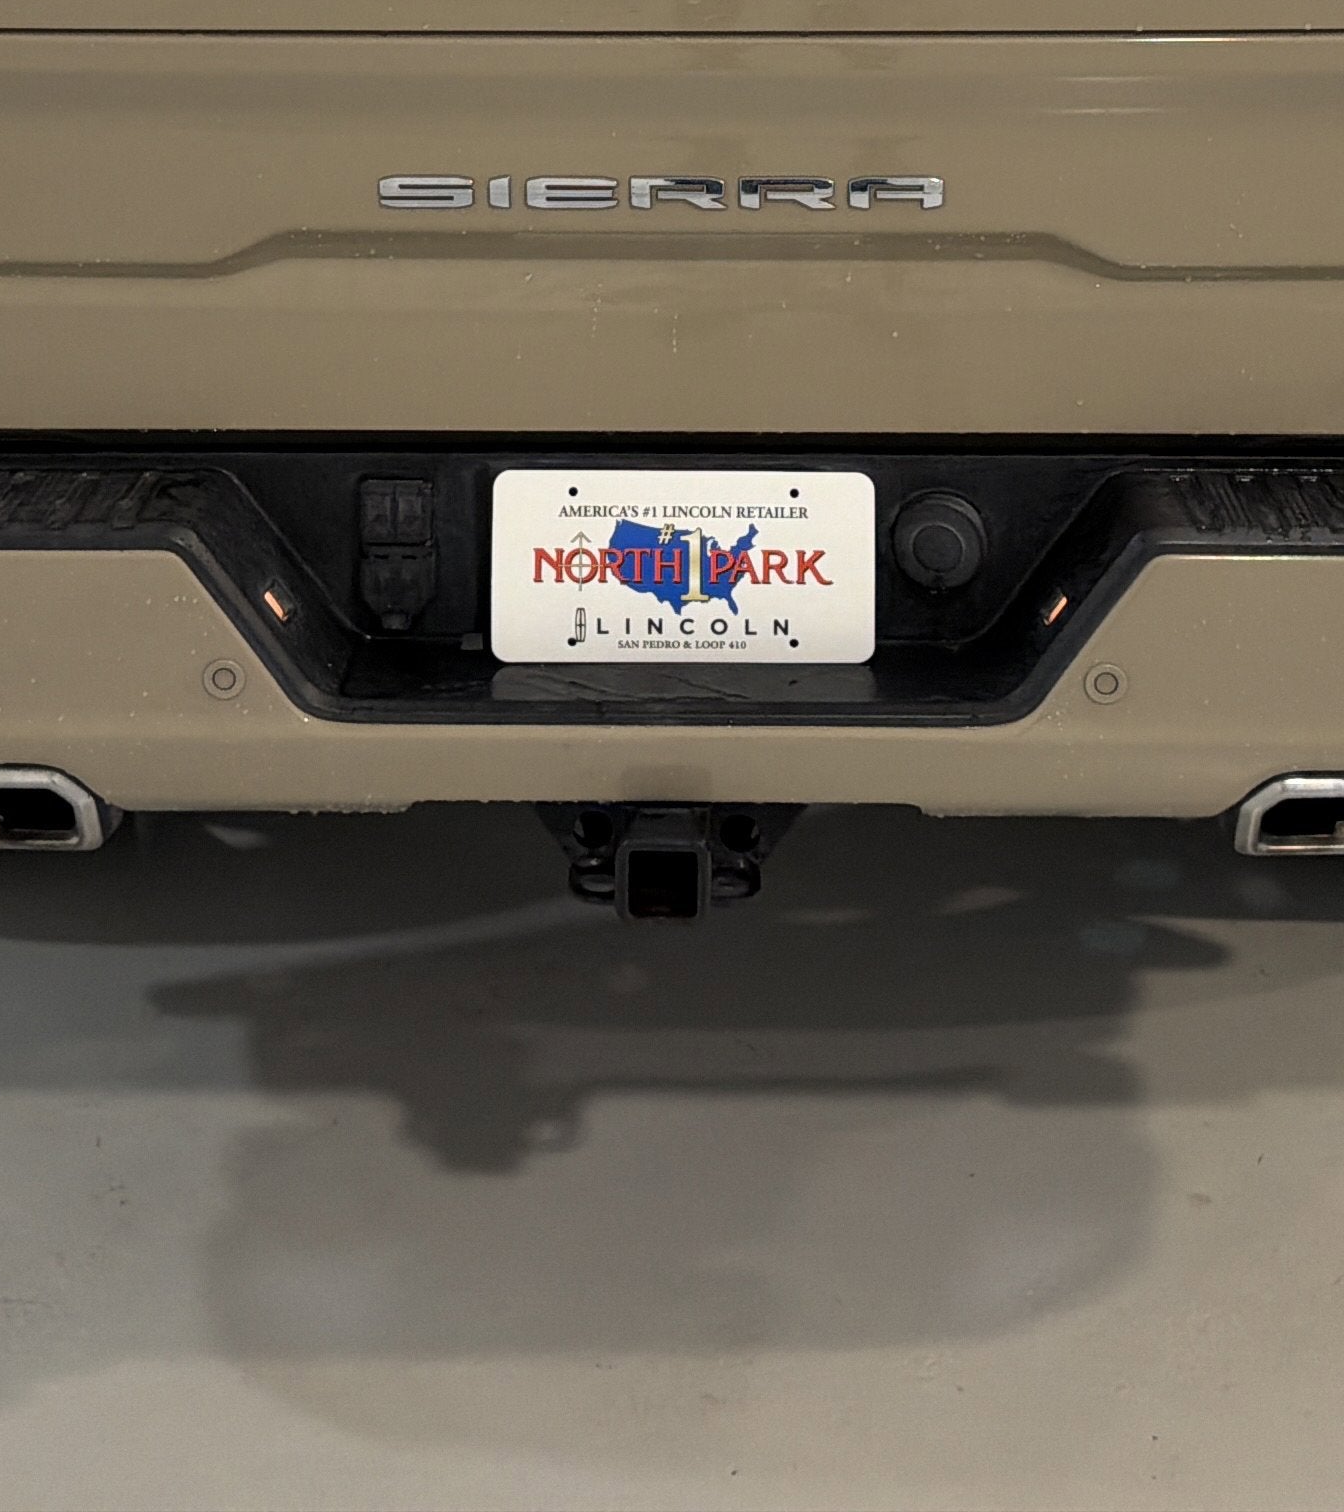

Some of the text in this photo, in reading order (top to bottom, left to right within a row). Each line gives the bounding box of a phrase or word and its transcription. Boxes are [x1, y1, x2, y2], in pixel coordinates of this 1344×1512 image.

[378, 175, 945, 210] SIERRA
[558, 505, 808, 519] AMERICA'S #1 LINCOLN RETAILER
[533, 548, 834, 585] NORTH PARK
[596, 618, 789, 636] LINCOLN
[617, 639, 747, 650] SAN PEDRO & LOOP 410
